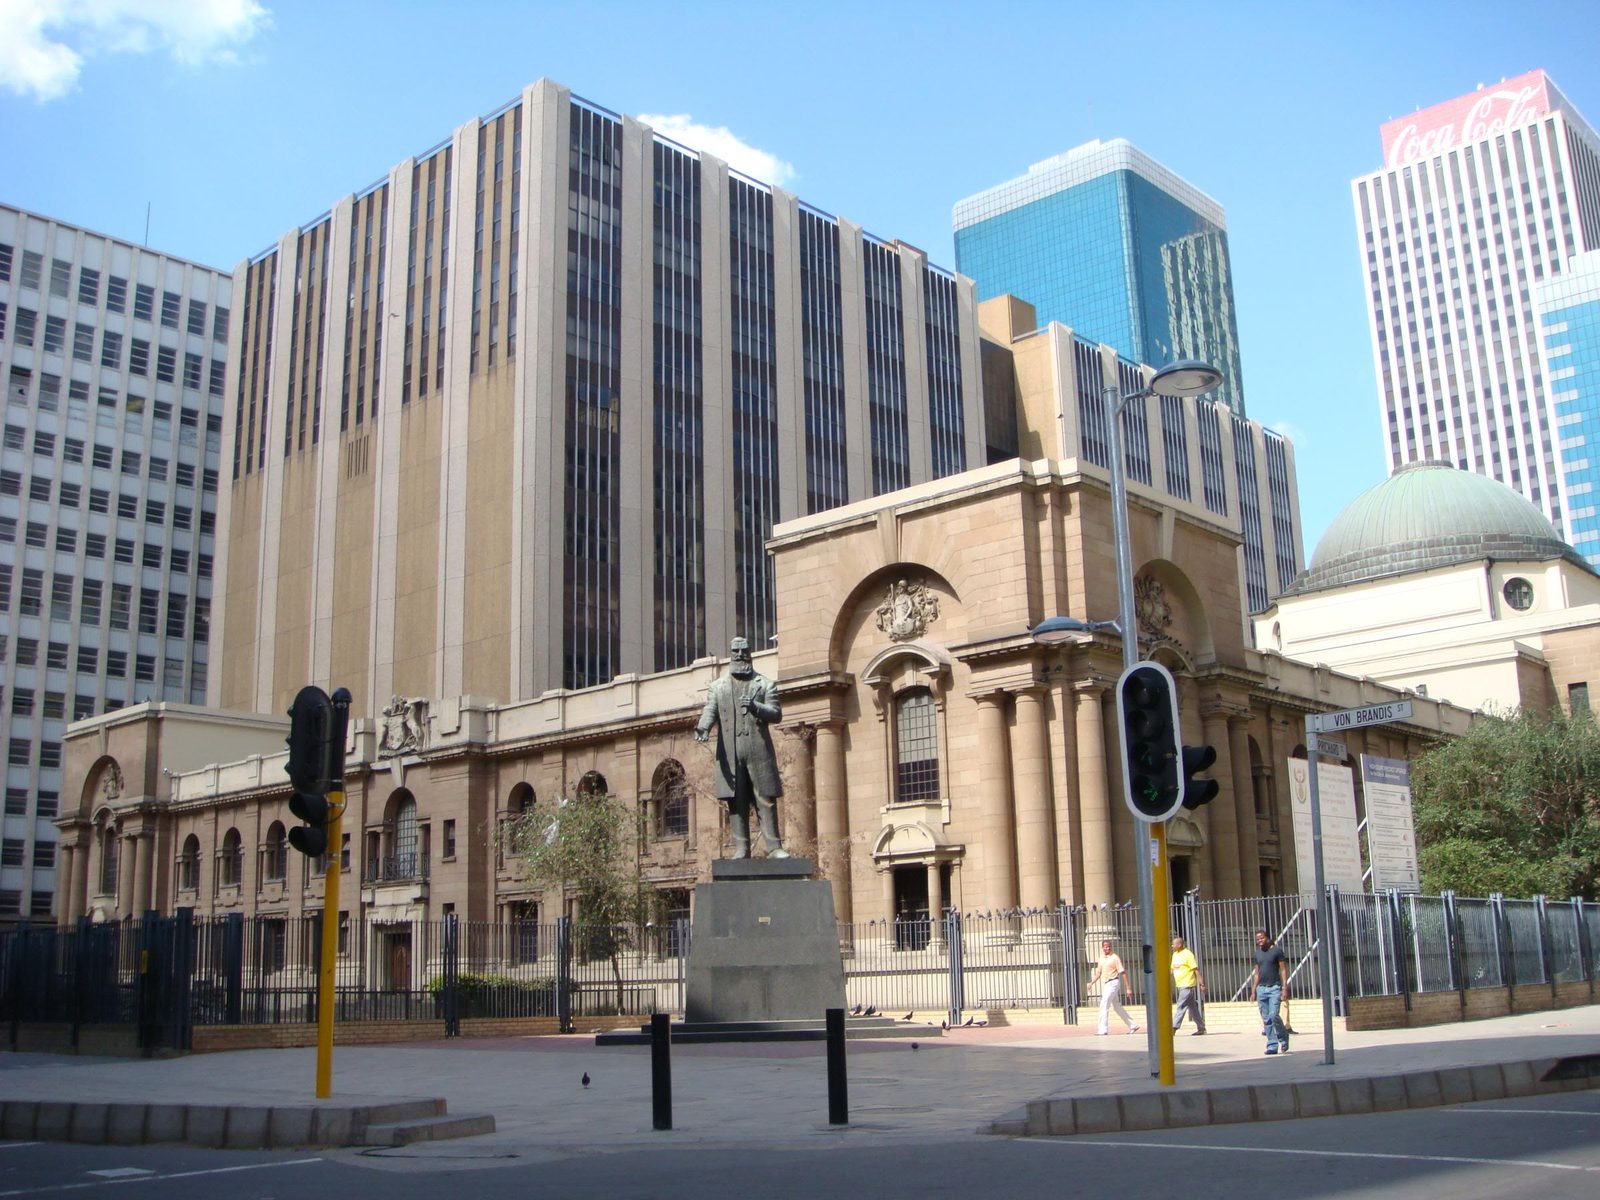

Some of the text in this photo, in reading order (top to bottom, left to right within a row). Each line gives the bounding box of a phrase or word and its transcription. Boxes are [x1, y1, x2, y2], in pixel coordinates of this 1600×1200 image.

[1334, 703, 1404, 727] VON BRANDIS ST
